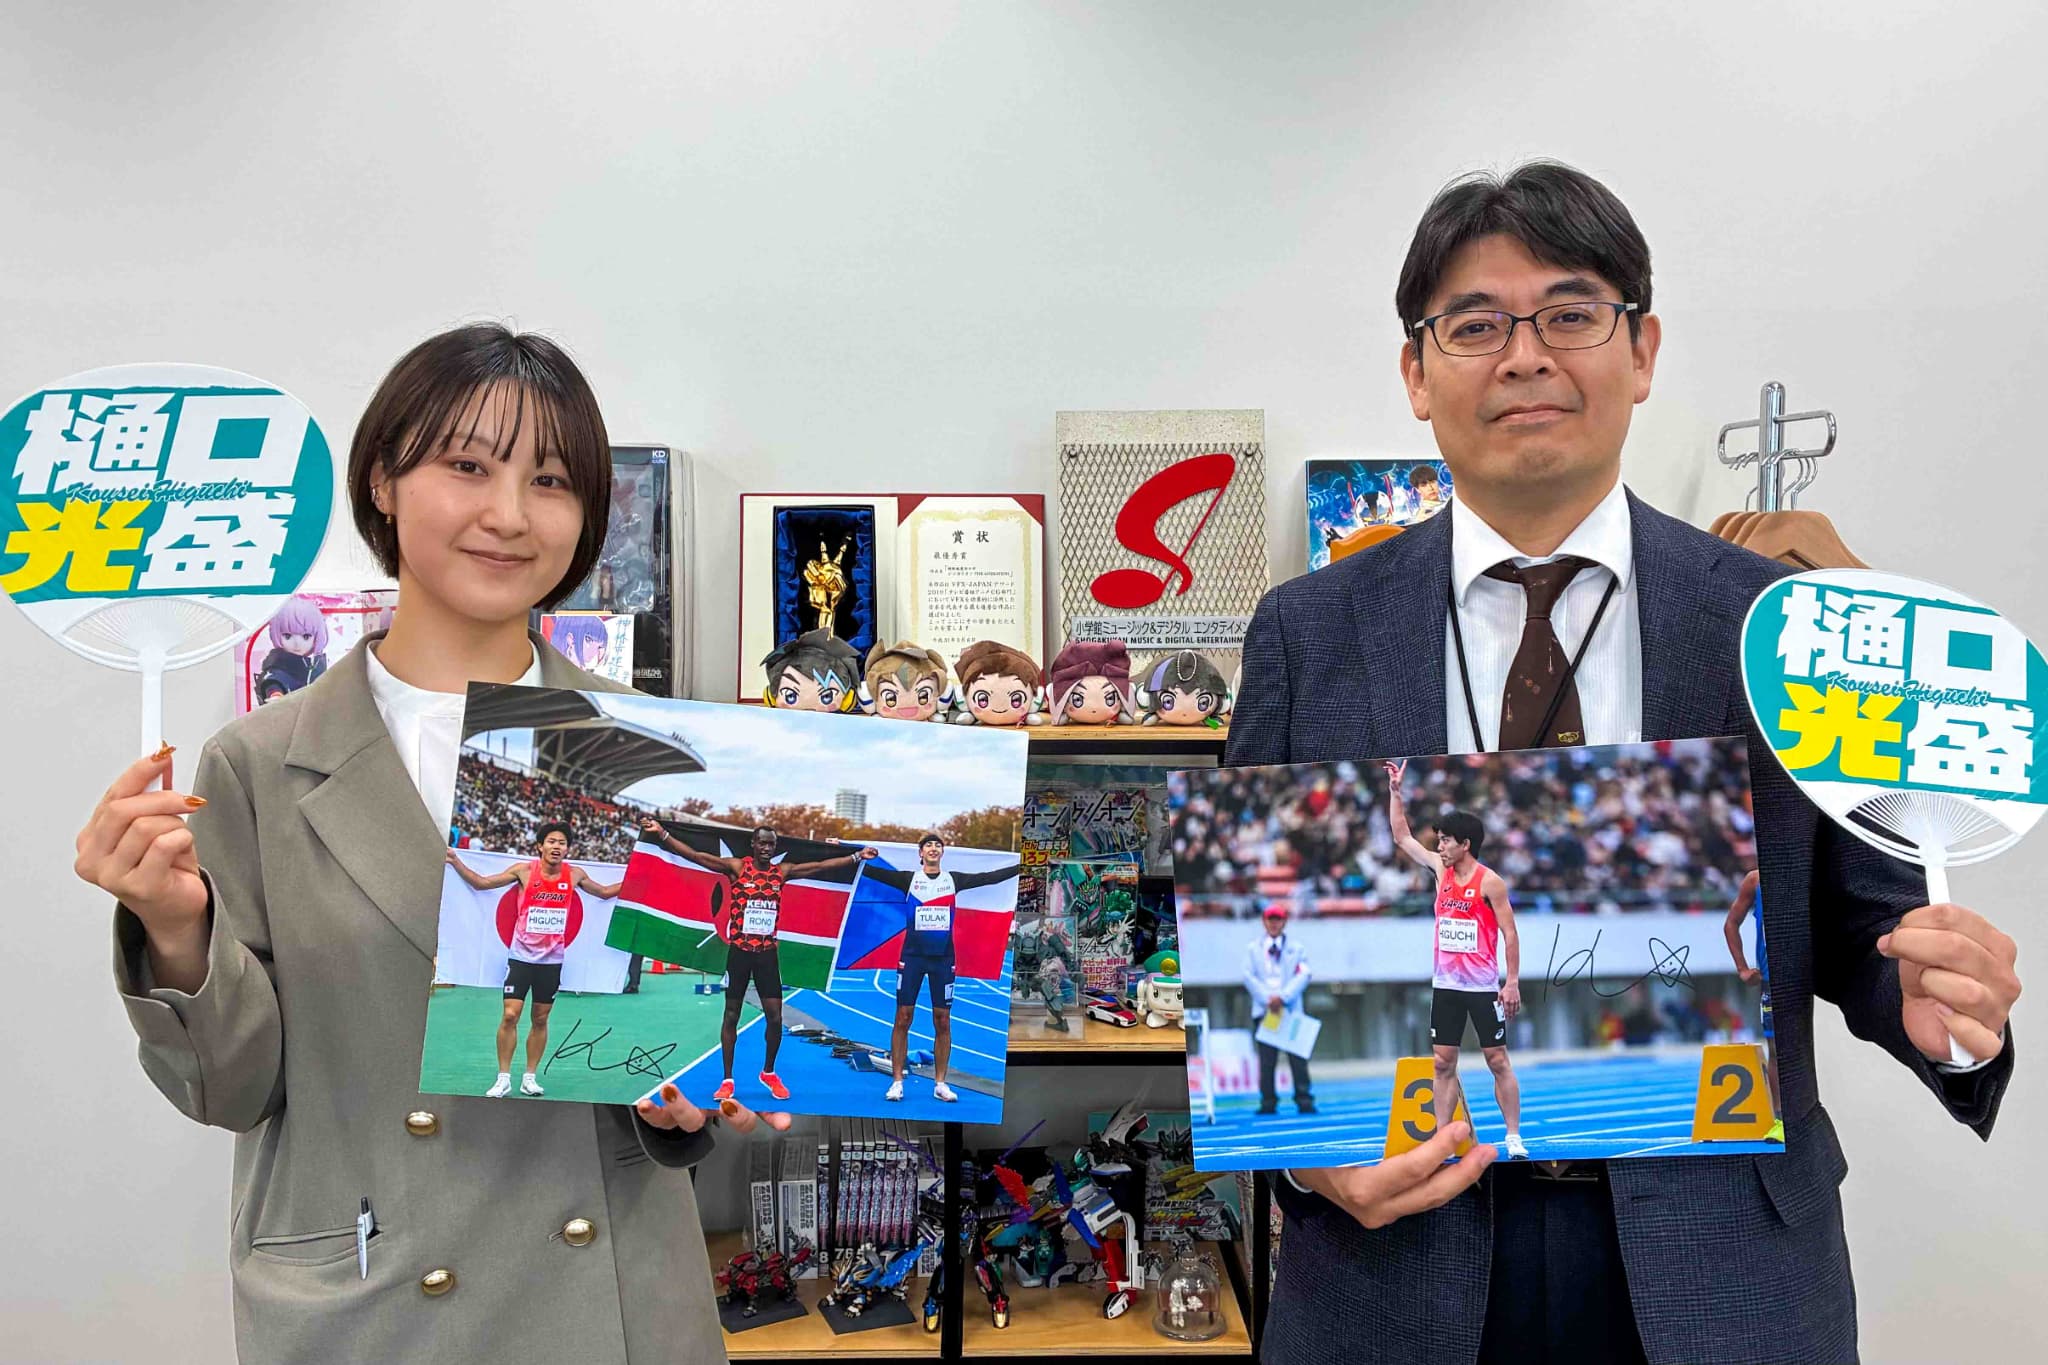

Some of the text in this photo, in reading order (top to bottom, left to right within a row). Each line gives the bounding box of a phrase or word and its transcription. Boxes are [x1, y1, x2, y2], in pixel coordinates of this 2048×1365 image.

[12, 393, 310, 495] 樋口
[67, 477, 250, 508] Kousei Higuchi
[0, 489, 296, 594] 光盛
[952, 530, 989, 544] 賞状
[1130, 636, 1155, 644] MUSIC
[1165, 636, 1195, 644] DIGITAL
[1776, 584, 2028, 701] 樋口
[1826, 671, 1992, 710] Kousei Higuchi
[1775, 682, 2035, 794] 光盛
[533, 892, 567, 901] JAPAN
[747, 899, 777, 909] KENYA
[1440, 899, 1472, 911] JAPAN
[529, 916, 565, 926] HIGUCHI
[749, 917, 772, 927] RONO
[920, 914, 946, 922] TULAK
[1711, 1064, 1757, 1124] 2
[1402, 1078, 1438, 1143] 3
[760, 1184, 773, 1226] ZOIDS
[805, 1184, 815, 1230] ZOIDS
[819, 1251, 830, 1264] 8
[834, 1247, 845, 1260] 7
